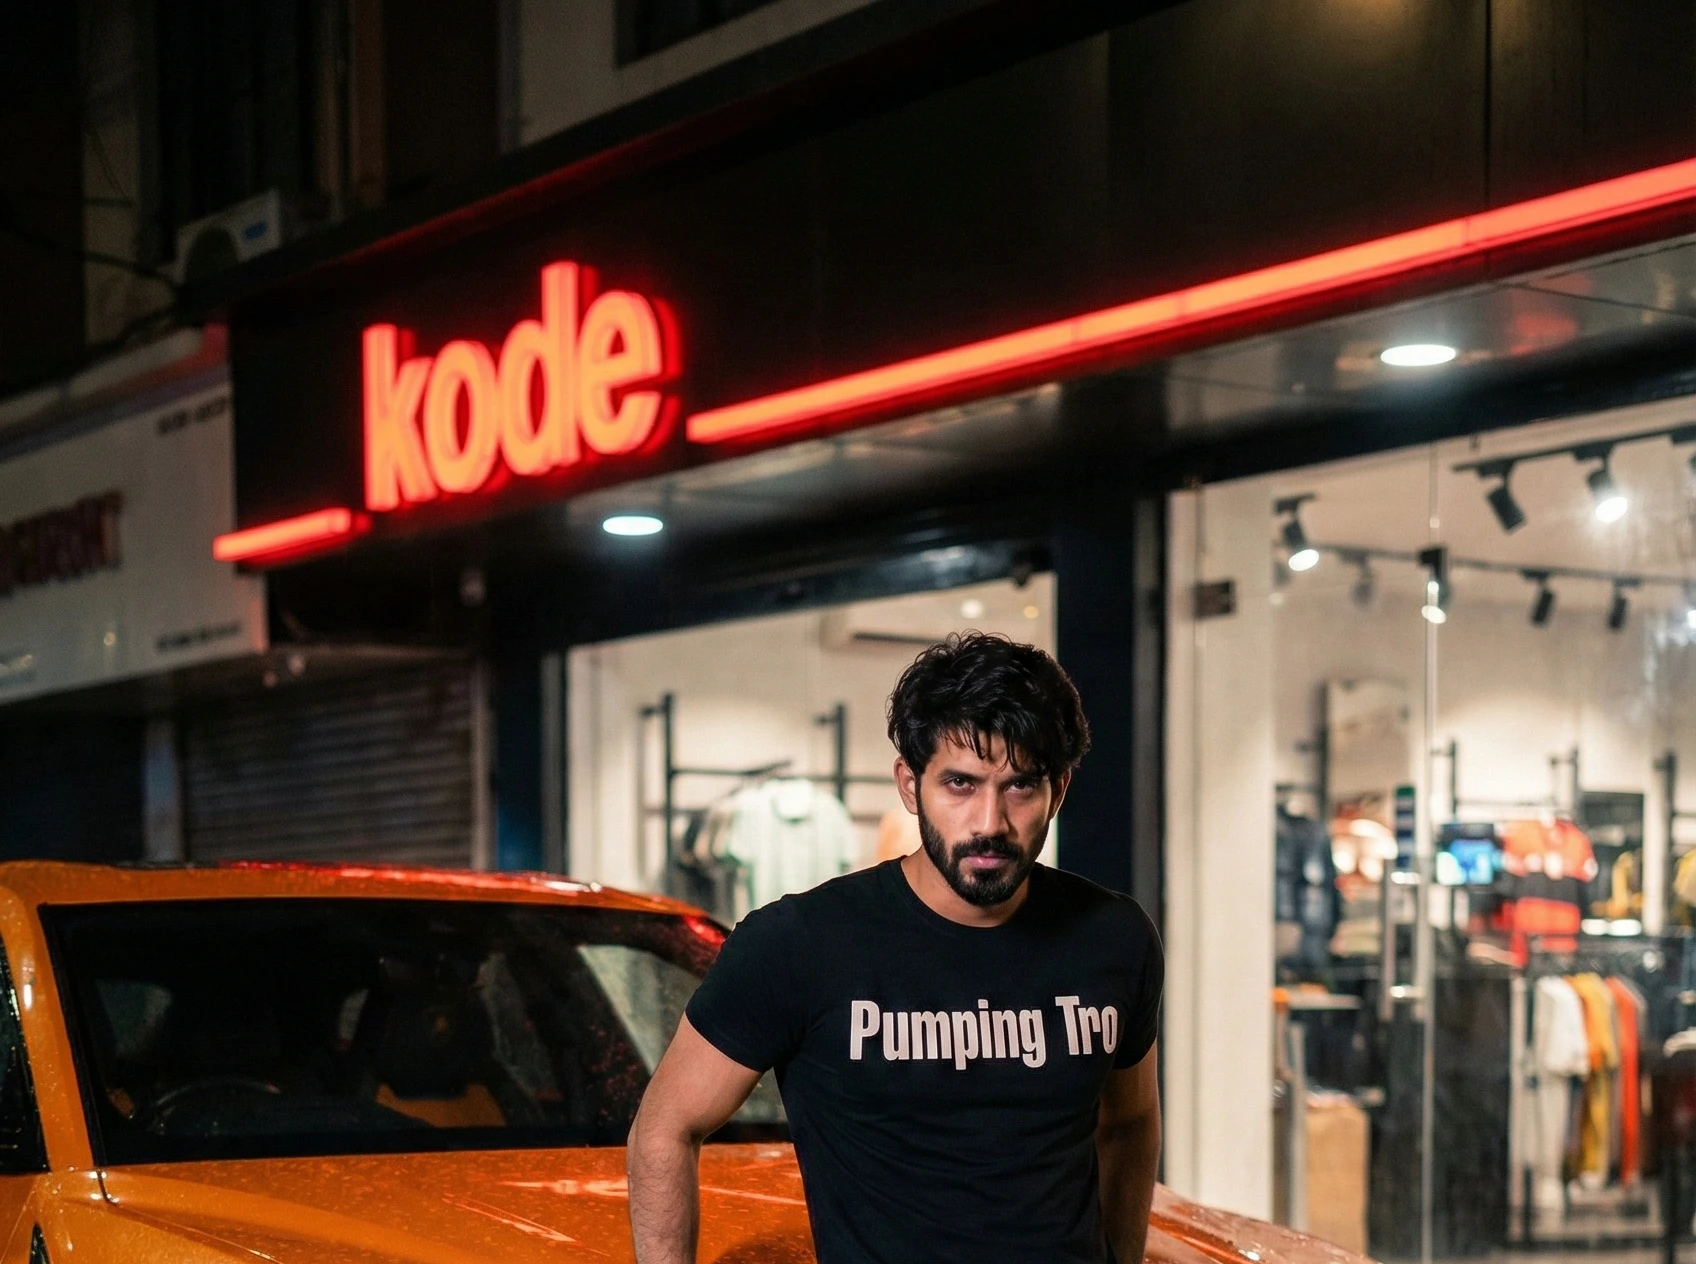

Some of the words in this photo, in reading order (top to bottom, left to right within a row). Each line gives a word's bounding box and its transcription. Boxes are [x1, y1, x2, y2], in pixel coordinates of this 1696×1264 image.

[362, 261, 674, 511] kode
[849, 998, 1047, 1071] Pumping
[1055, 995, 1119, 1056] Tro
